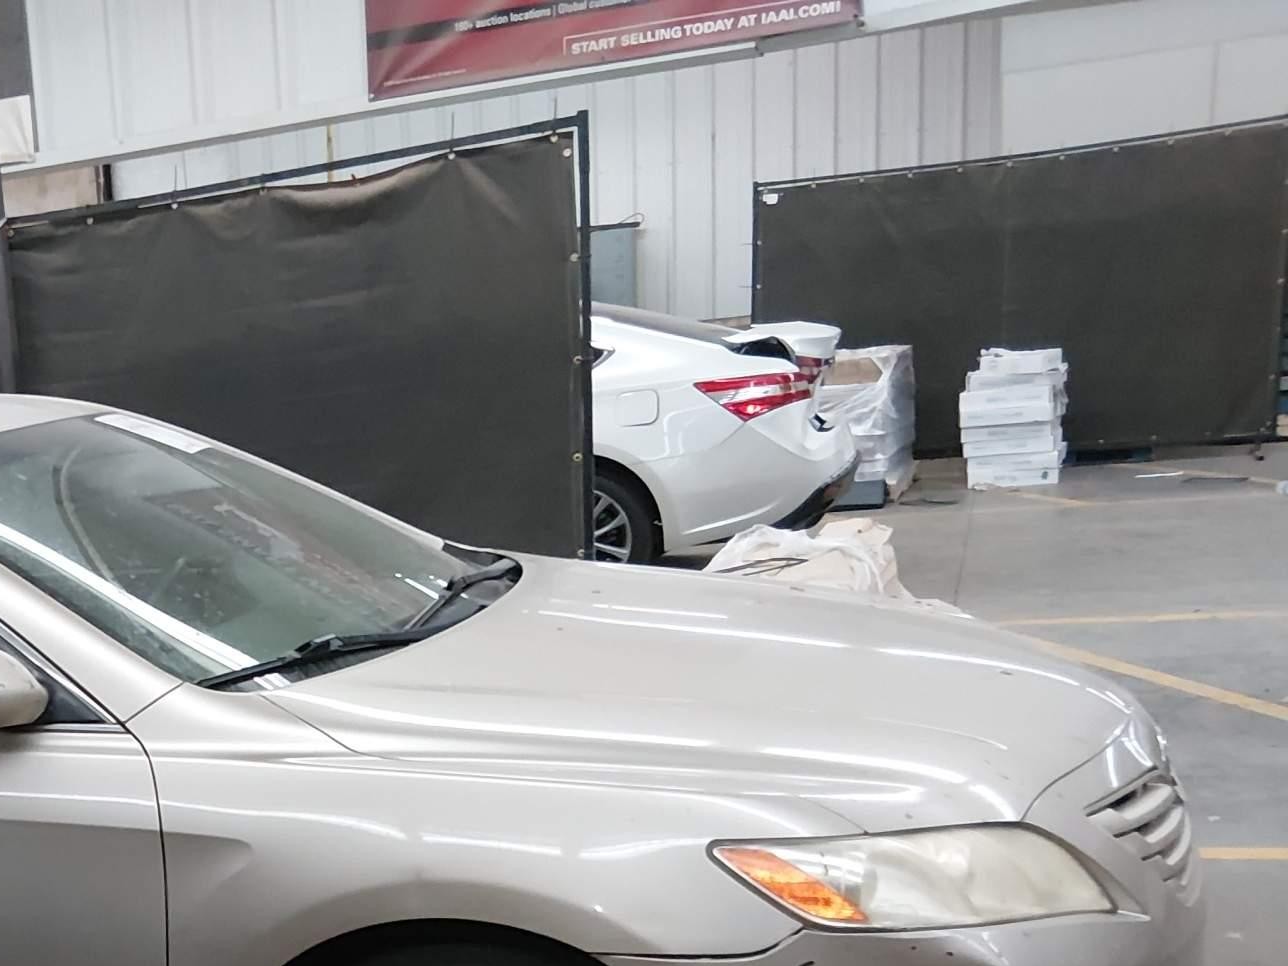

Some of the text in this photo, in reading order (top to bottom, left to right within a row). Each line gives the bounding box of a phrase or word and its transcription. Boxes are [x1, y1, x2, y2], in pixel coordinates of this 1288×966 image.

[475, 15, 509, 28] auction
[510, 8, 551, 22] locations
[571, 1, 842, 55] START SELLING TODAY AT IAAI.COM!
